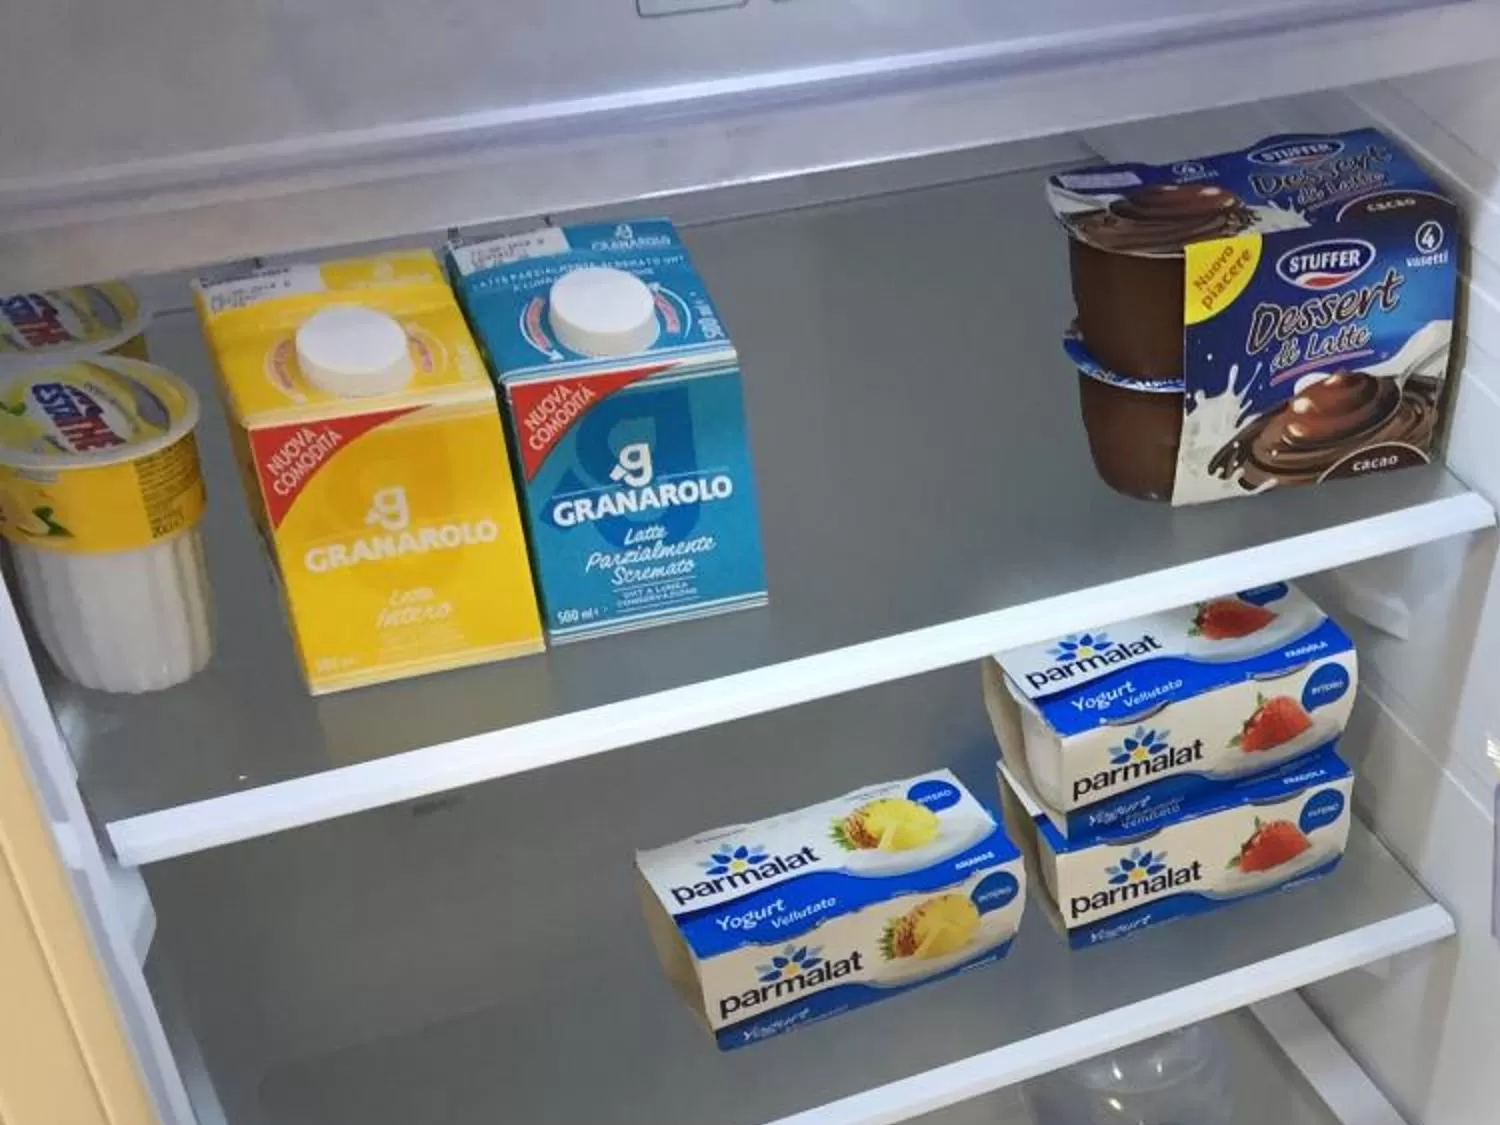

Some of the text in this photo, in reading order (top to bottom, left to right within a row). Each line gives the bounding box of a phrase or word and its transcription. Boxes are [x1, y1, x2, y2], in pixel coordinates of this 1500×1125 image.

[1261, 143, 1331, 161] STUFFER
[1194, 245, 1235, 292] Nuovo
[1200, 247, 1252, 311] piacere
[1289, 249, 1360, 273] STUFFER
[1405, 250, 1448, 268] vasetti
[1246, 268, 1405, 354] Dessert
[1270, 322, 1372, 372] di Latte
[526, 384, 572, 432] NUOVA
[528, 385, 596, 451] COMODITÀ
[267, 428, 316, 475] NUOVA
[1352, 453, 1400, 473] cacao
[552, 475, 733, 527] GRANAROLO
[304, 519, 498, 573] GRANAROLO
[585, 536, 717, 574] Parzialmente
[624, 524, 668, 546] Latte
[611, 559, 695, 586] Scremato
[557, 609, 580, 625] 500
[1024, 635, 1162, 691] parmalat
[1071, 680, 1137, 714] Yogurt
[1122, 678, 1184, 709] Vellutato
[1072, 739, 1204, 801] parmalat
[670, 845, 821, 906] parmalat
[1071, 859, 1203, 920] parmalat
[715, 897, 788, 934] Yogurt
[770, 896, 838, 930] Vellutato
[719, 950, 864, 1021] parmalat
